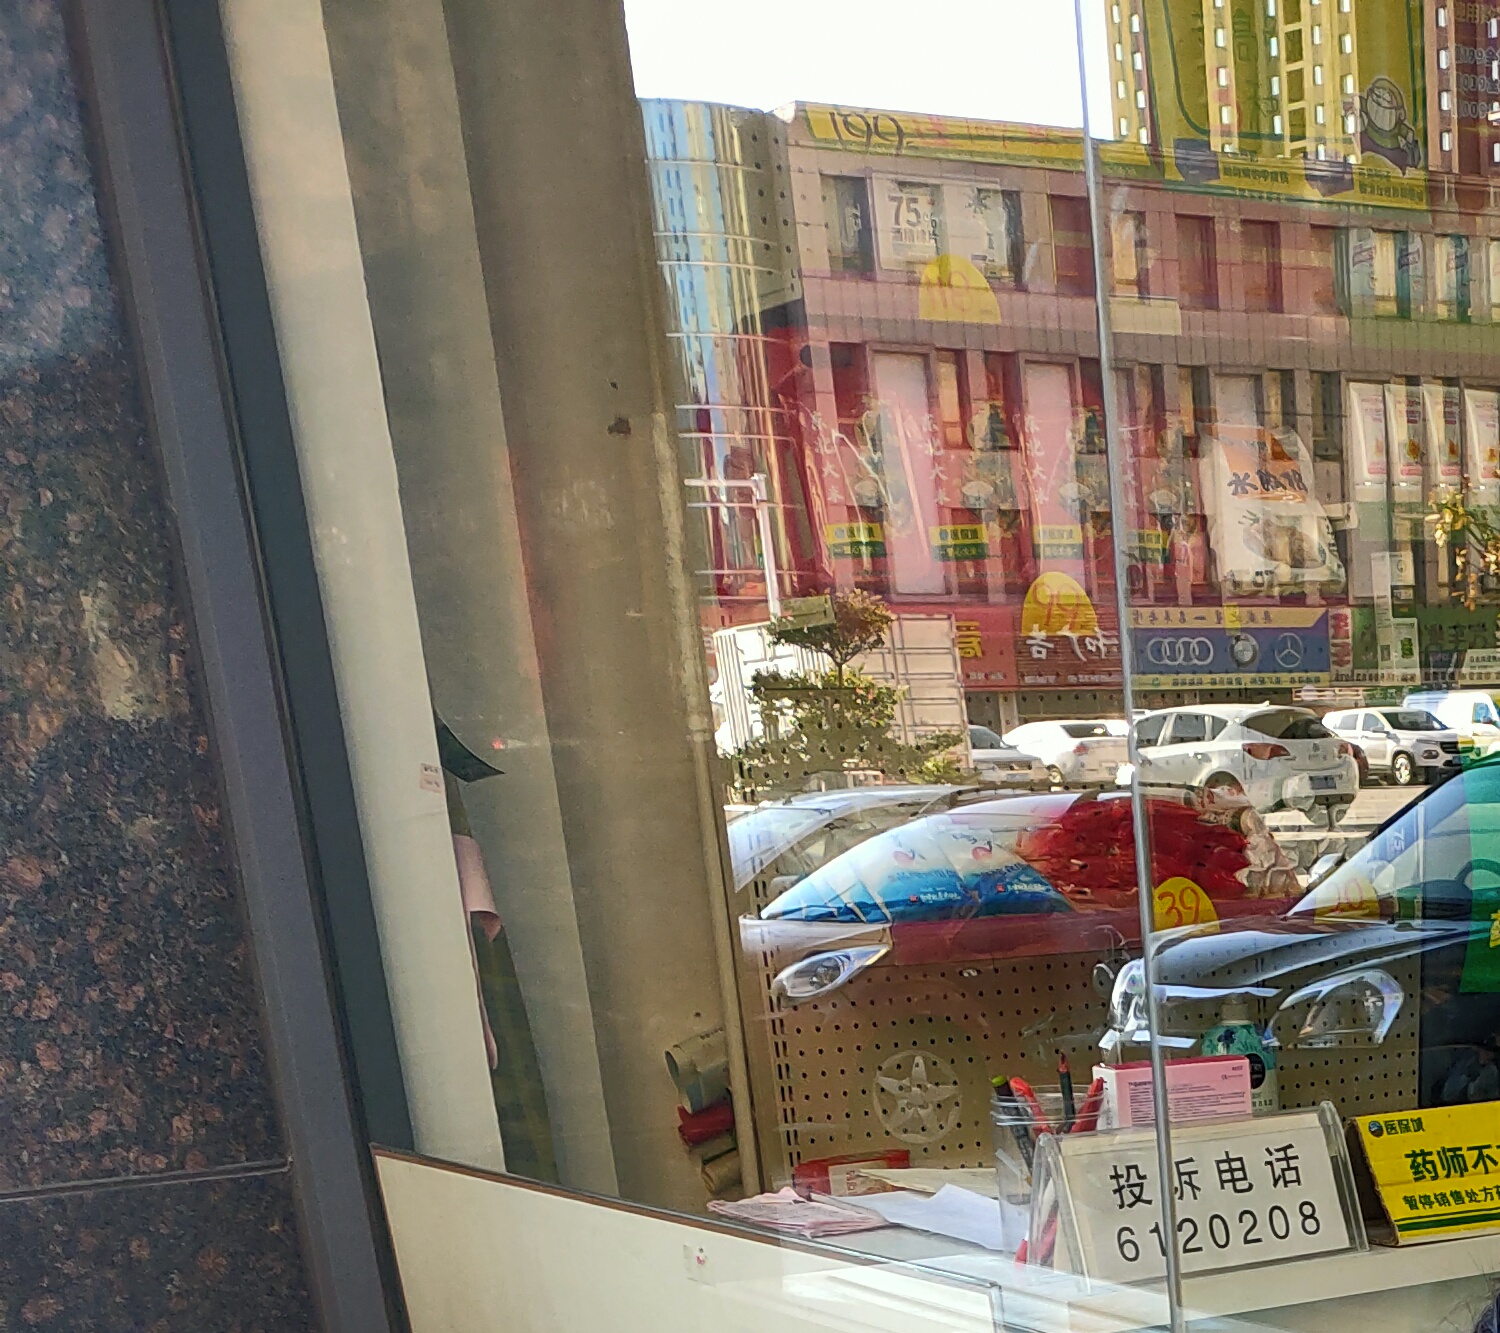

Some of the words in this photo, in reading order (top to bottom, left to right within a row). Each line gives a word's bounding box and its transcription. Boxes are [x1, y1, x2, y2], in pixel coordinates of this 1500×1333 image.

[1384, 1116, 1427, 1136] 医保城
[1109, 1142, 1304, 1212] 投诉电话
[1115, 1199, 1322, 1264] 6120208
